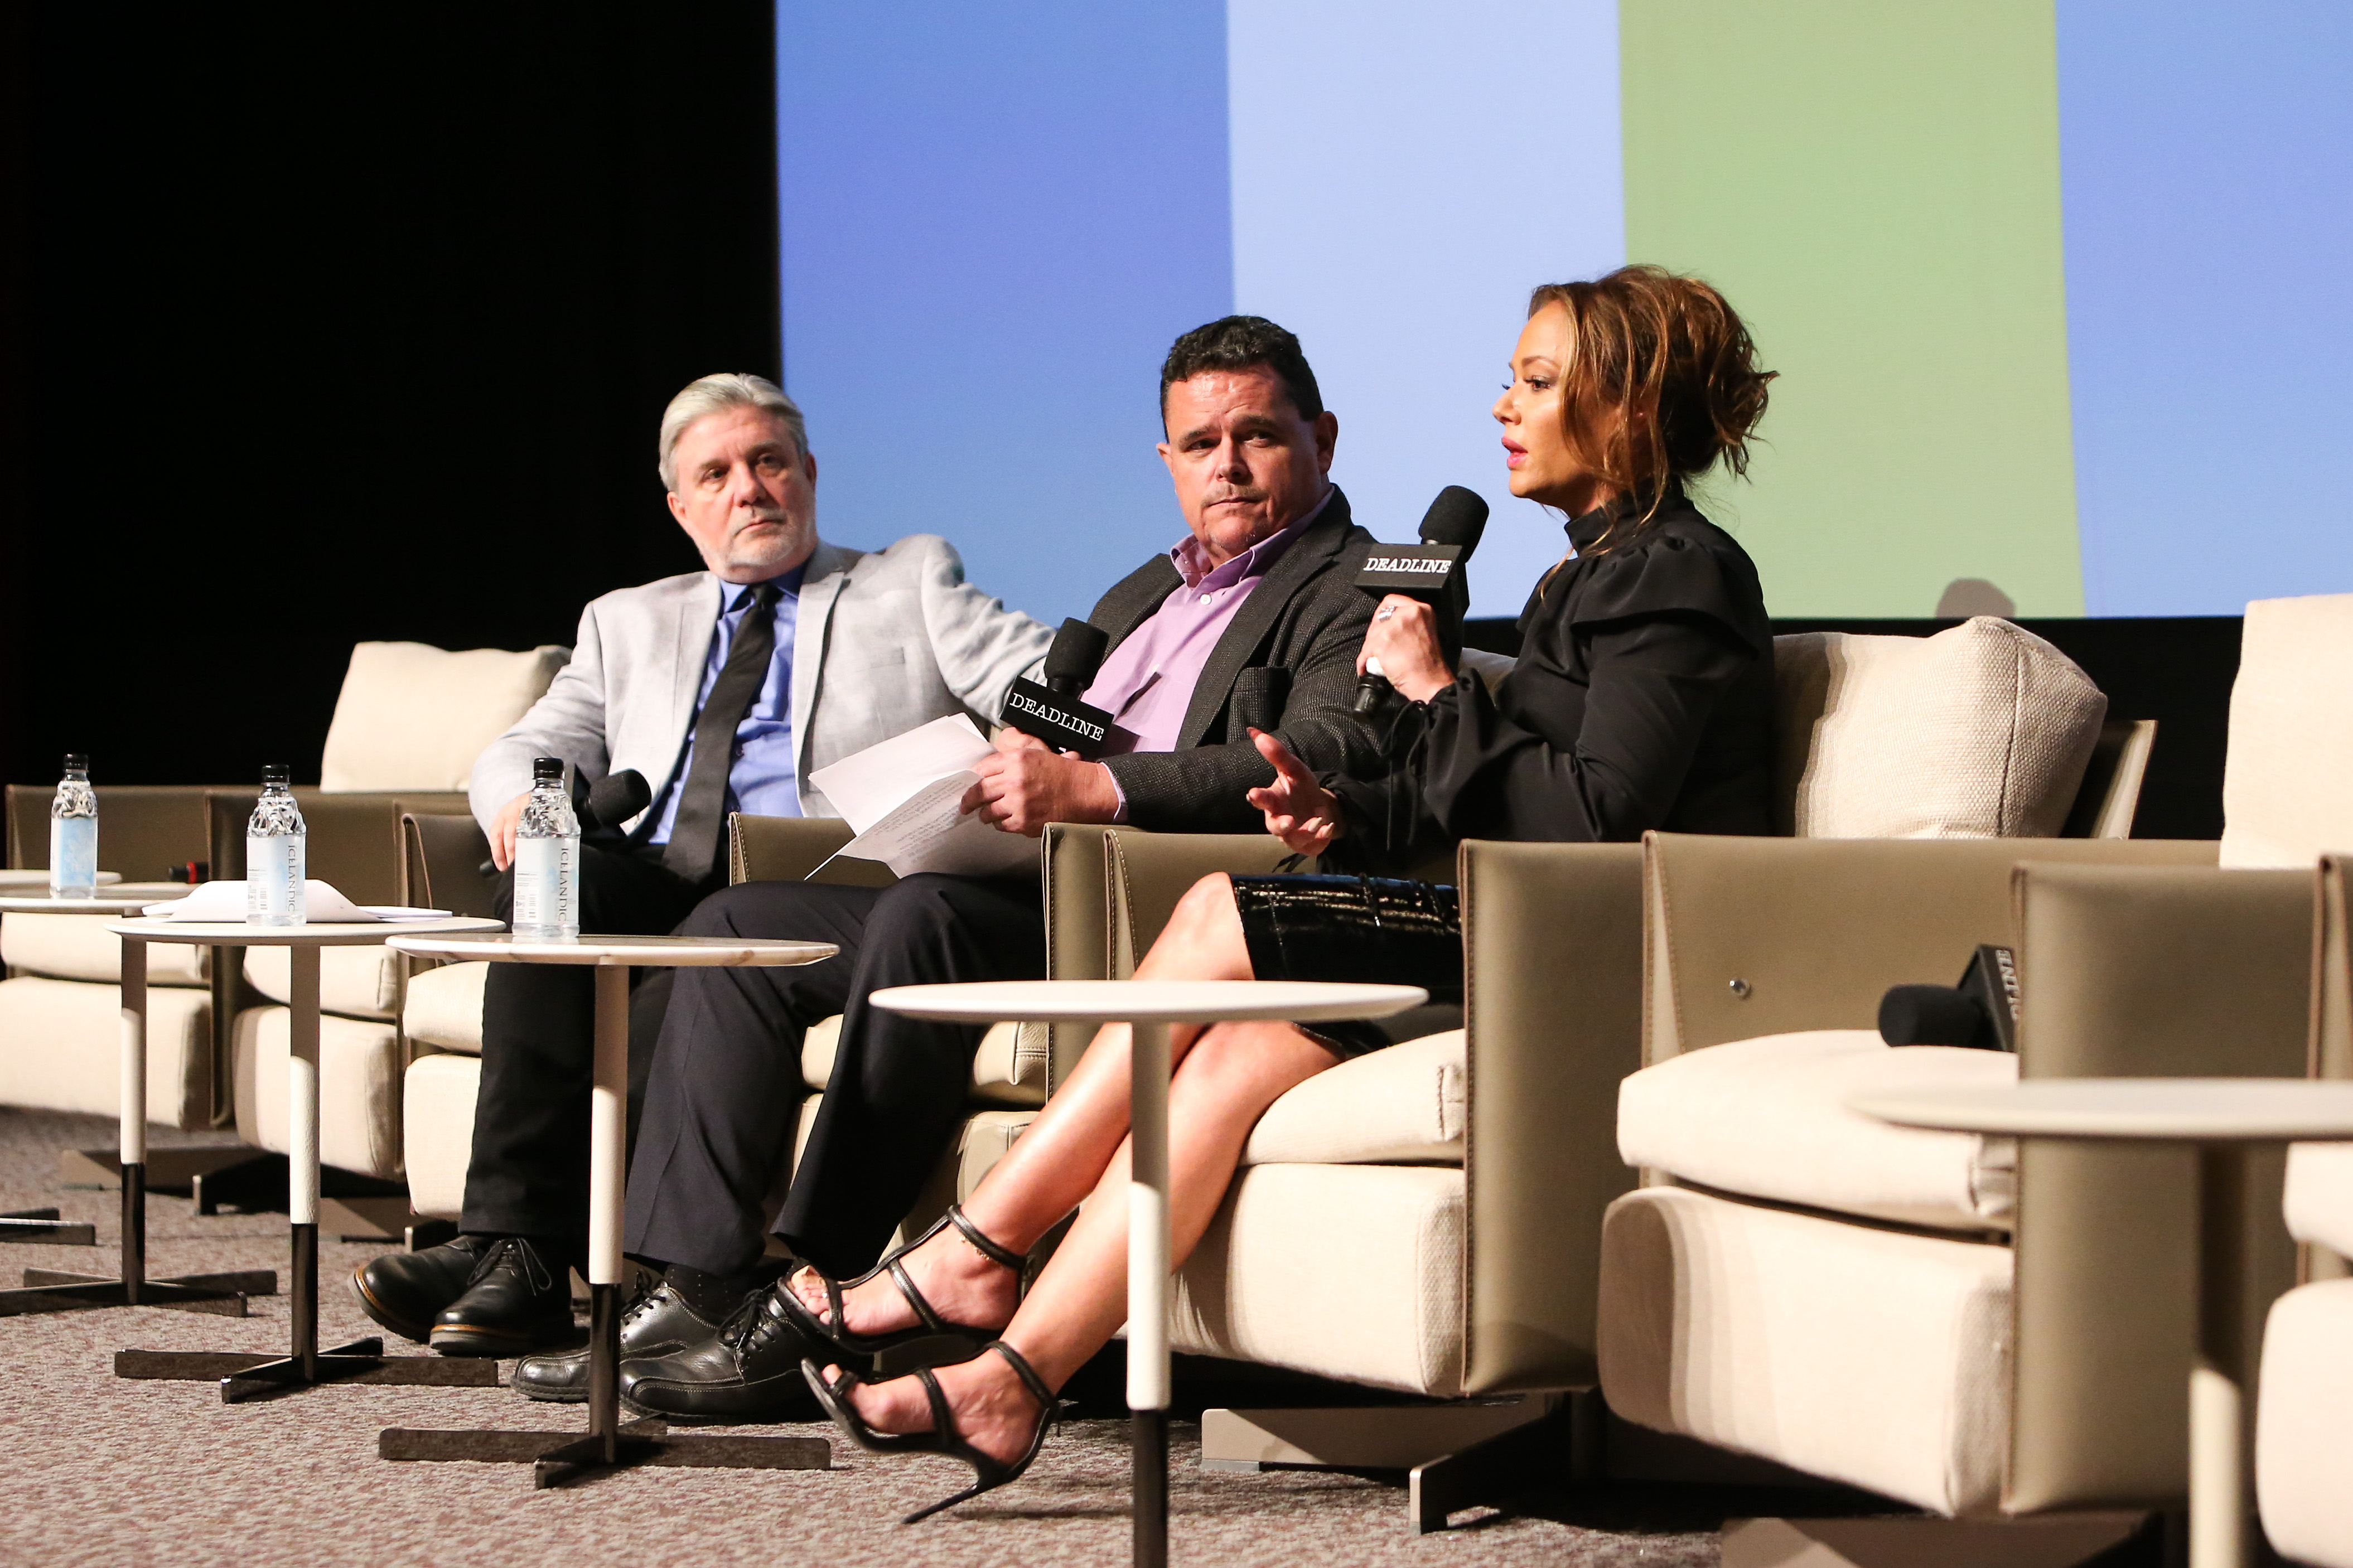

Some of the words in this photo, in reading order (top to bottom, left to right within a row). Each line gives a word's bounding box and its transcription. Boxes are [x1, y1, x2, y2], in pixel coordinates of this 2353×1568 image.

[1363, 558, 1452, 574] DEADLINE
[1009, 693, 1104, 742] DEADLINE
[288, 845, 296, 912] ICELANDIC
[558, 848, 569, 921] ICELANDIC
